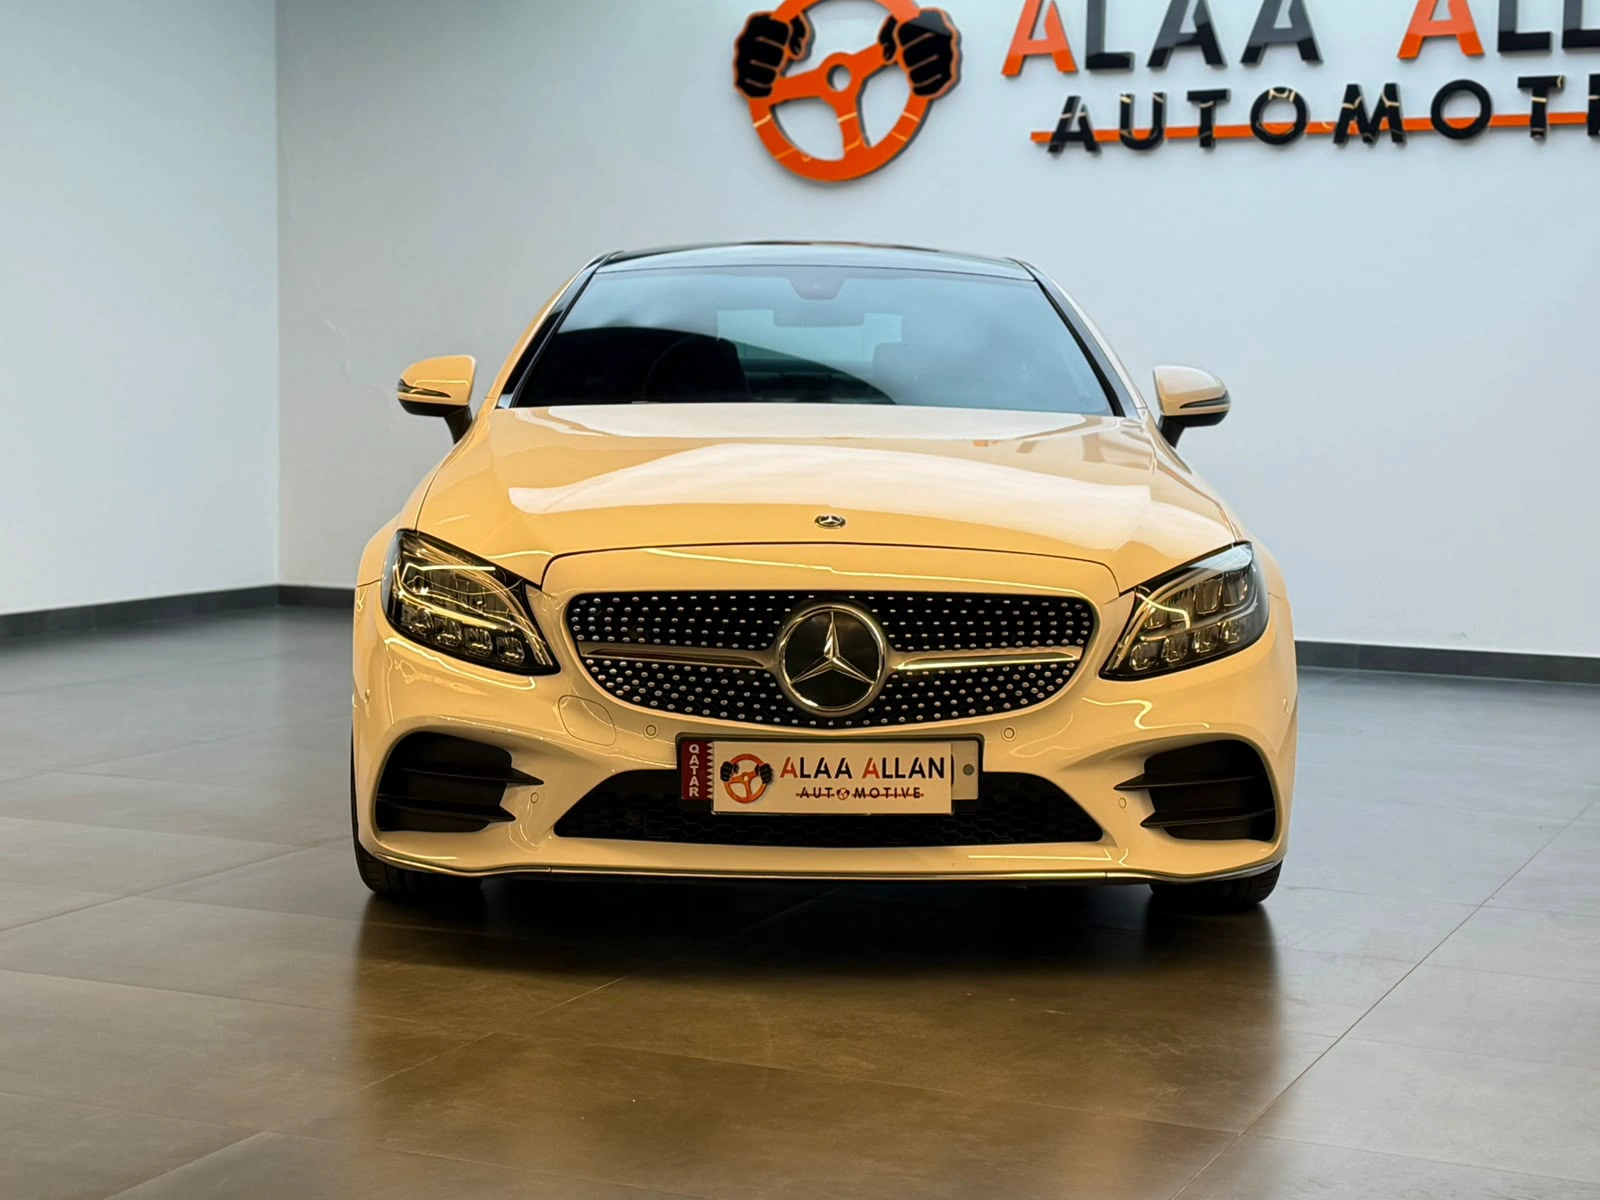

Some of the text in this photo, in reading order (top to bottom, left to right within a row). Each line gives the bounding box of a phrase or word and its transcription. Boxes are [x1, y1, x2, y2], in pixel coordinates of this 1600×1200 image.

[1001, 0, 1323, 76] ALAA
[688, 743, 700, 798] QATAR
[780, 757, 945, 779] ALAA ALLAN
[799, 787, 921, 800] AUTOMOTIVE
